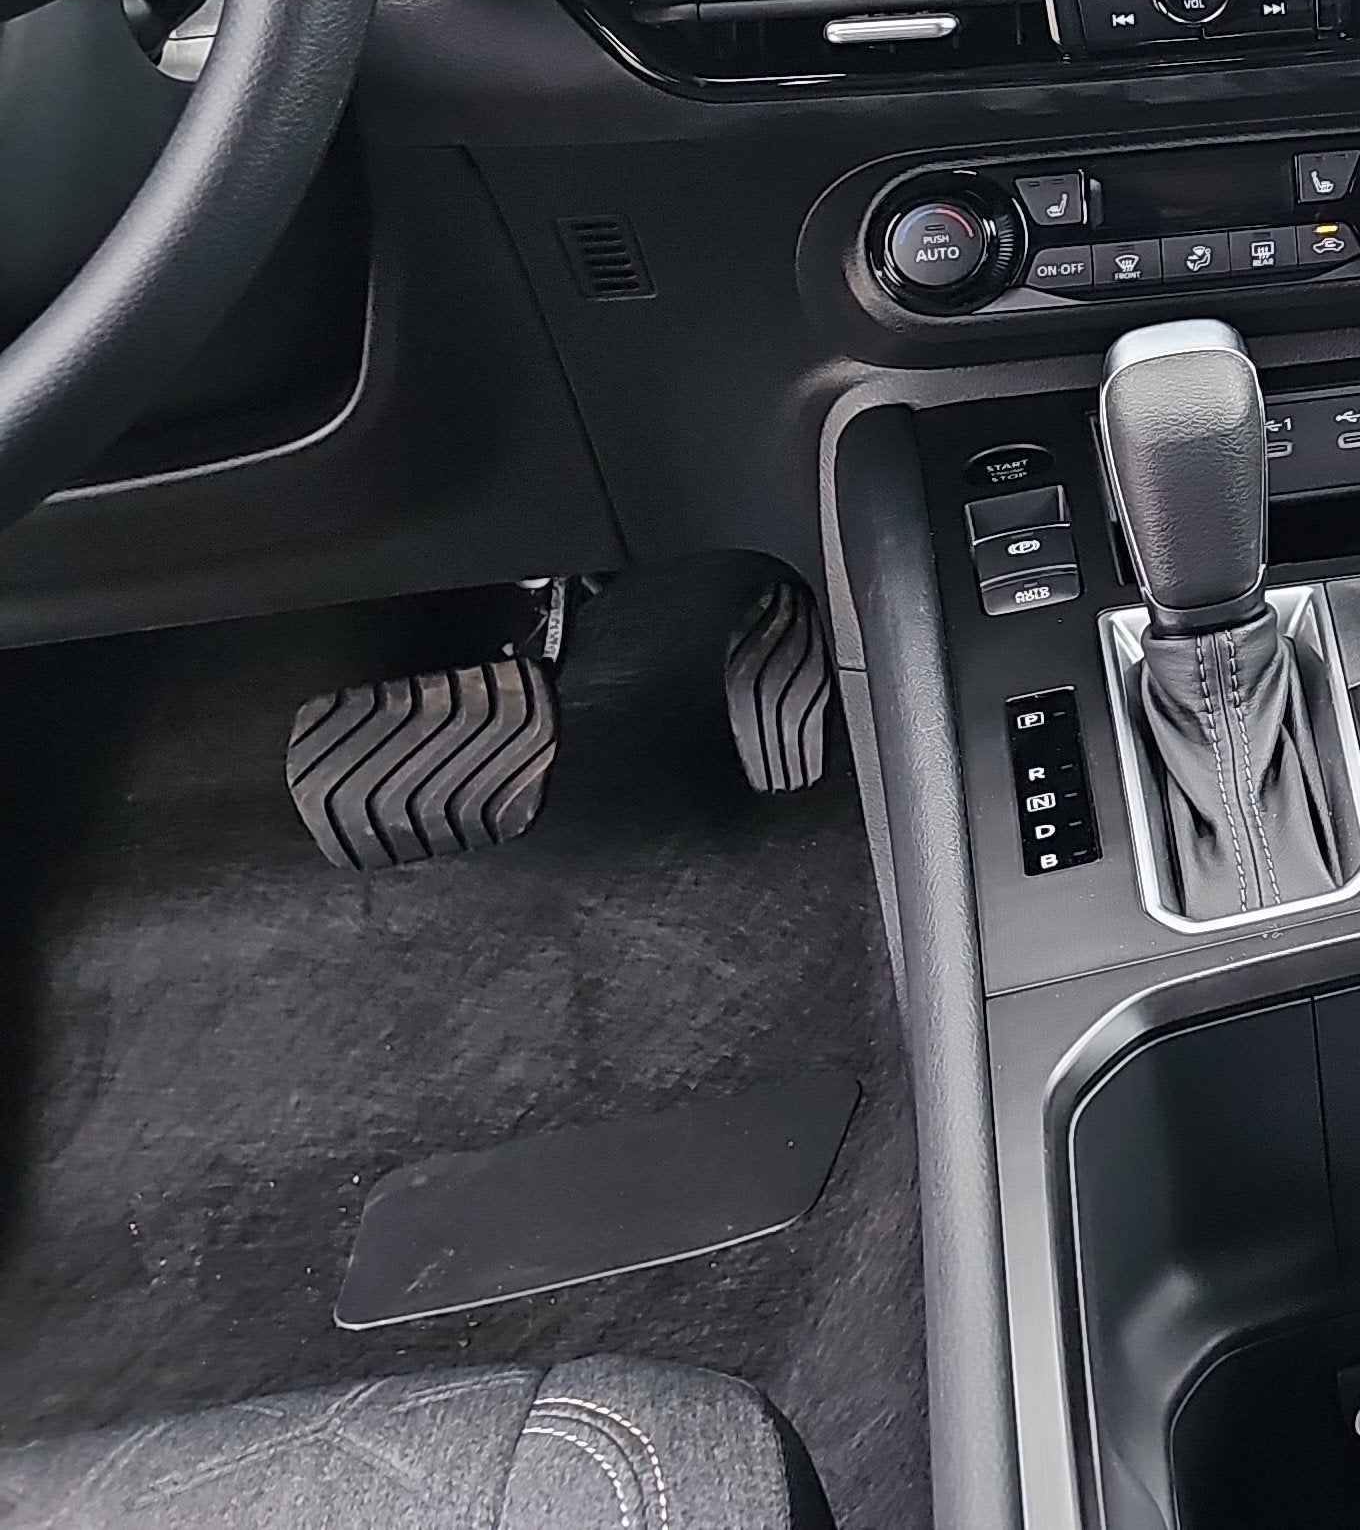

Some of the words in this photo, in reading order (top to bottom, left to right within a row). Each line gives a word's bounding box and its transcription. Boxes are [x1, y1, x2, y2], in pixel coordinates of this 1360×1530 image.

[923, 234, 950, 244] PUSH
[915, 246, 960, 263] AUTO
[1114, 271, 1142, 281] FRONT
[1283, 417, 1292, 431] 1
[986, 459, 1029, 473] START
[991, 471, 1028, 483] STOP
[1028, 767, 1046, 782] R
[1035, 824, 1056, 840] D
[1040, 853, 1059, 870] B
